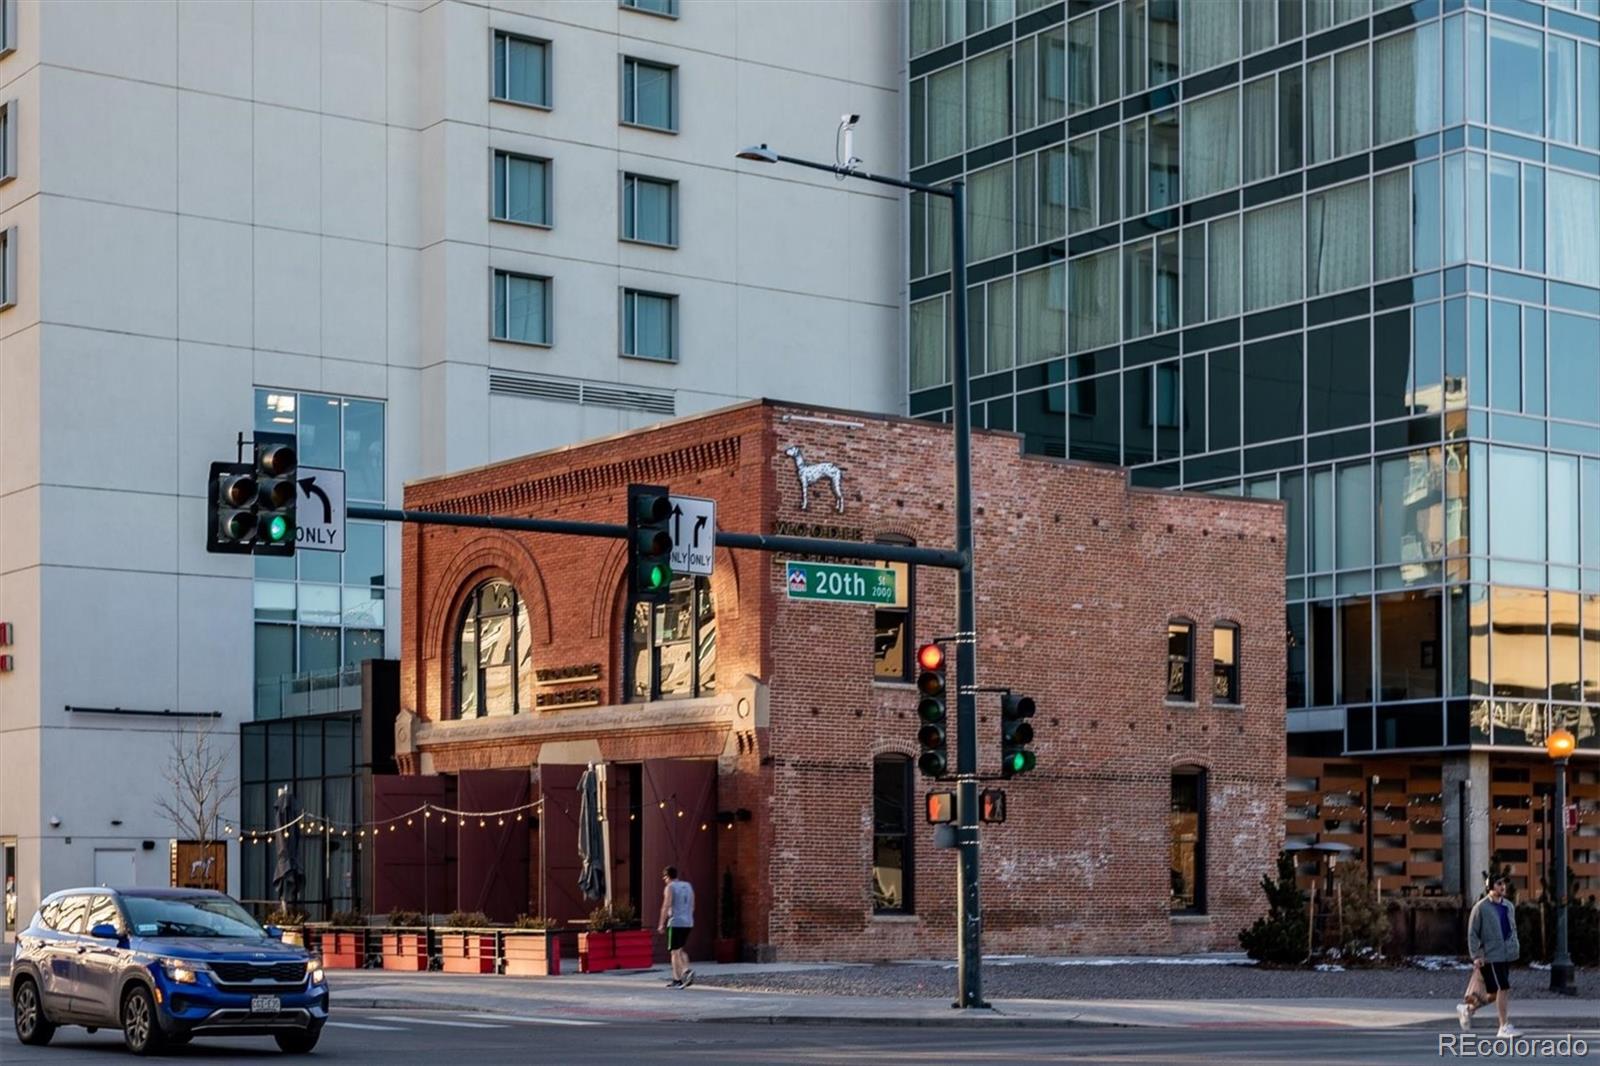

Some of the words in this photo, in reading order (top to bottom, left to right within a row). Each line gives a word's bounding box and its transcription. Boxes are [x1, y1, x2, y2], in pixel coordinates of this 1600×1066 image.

[296, 527, 337, 545] ONLY
[671, 552, 688, 565] NLY
[689, 553, 712, 566] ONLY
[816, 571, 865, 597] 20th
